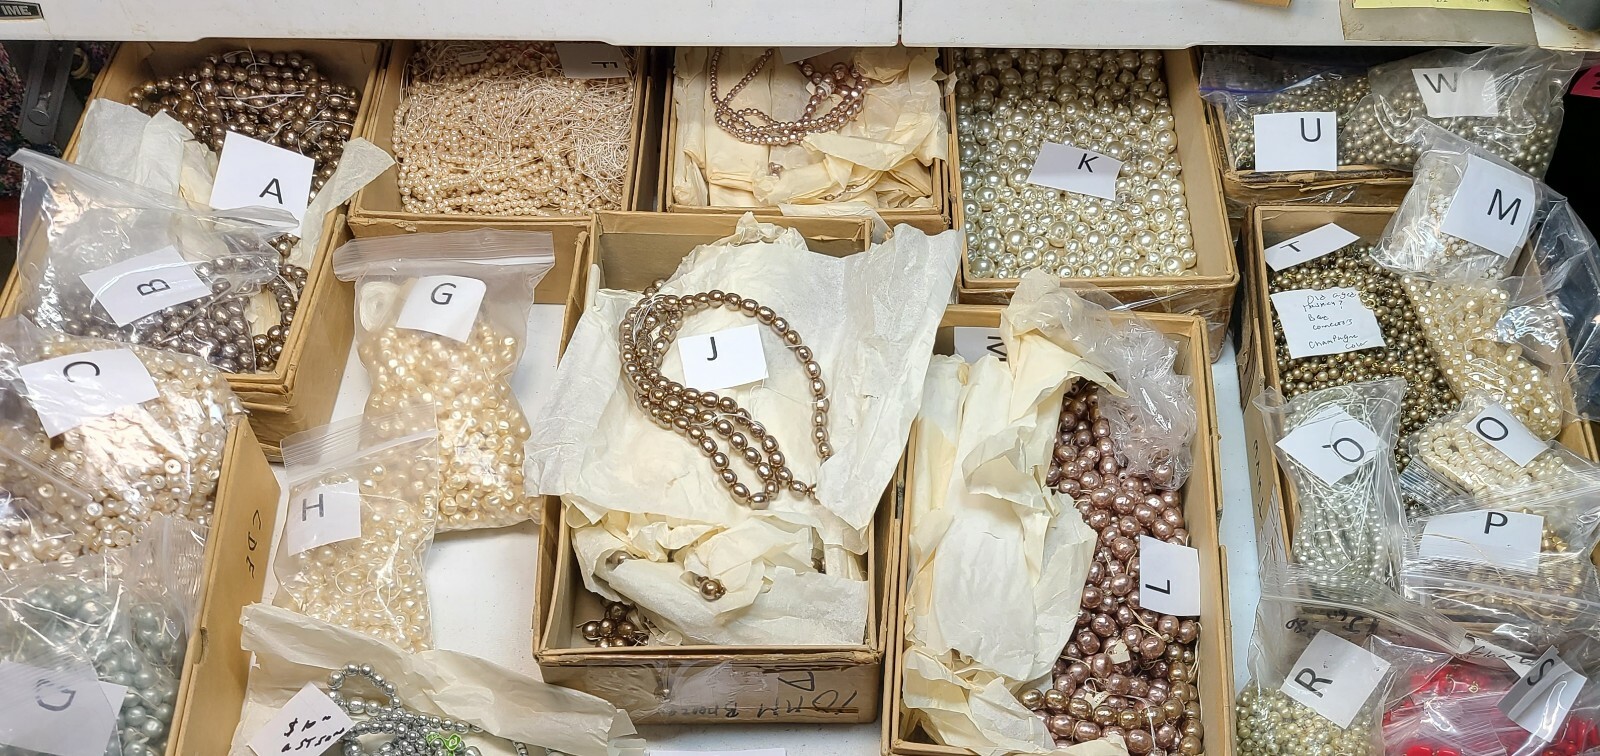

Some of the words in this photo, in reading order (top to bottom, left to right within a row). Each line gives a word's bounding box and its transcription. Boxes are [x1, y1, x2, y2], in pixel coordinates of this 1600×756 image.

[1423, 72, 1458, 93] W
[1300, 117, 1321, 142] U
[1077, 153, 1099, 173] K
[259, 178, 284, 204] A
[1487, 188, 1522, 226] M
[1279, 240, 1301, 253] T
[136, 278, 171, 296] B
[430, 283, 454, 305] G
[707, 337, 717, 361] J
[63, 361, 100, 382] C
[1475, 415, 1509, 441] O
[1321, 437, 1364, 463] Q
[302, 493, 324, 521] H
[1484, 510, 1508, 534] P
[1145, 578, 1170, 595] L
[1294, 666, 1333, 699] R
[1527, 658, 1554, 686] S
